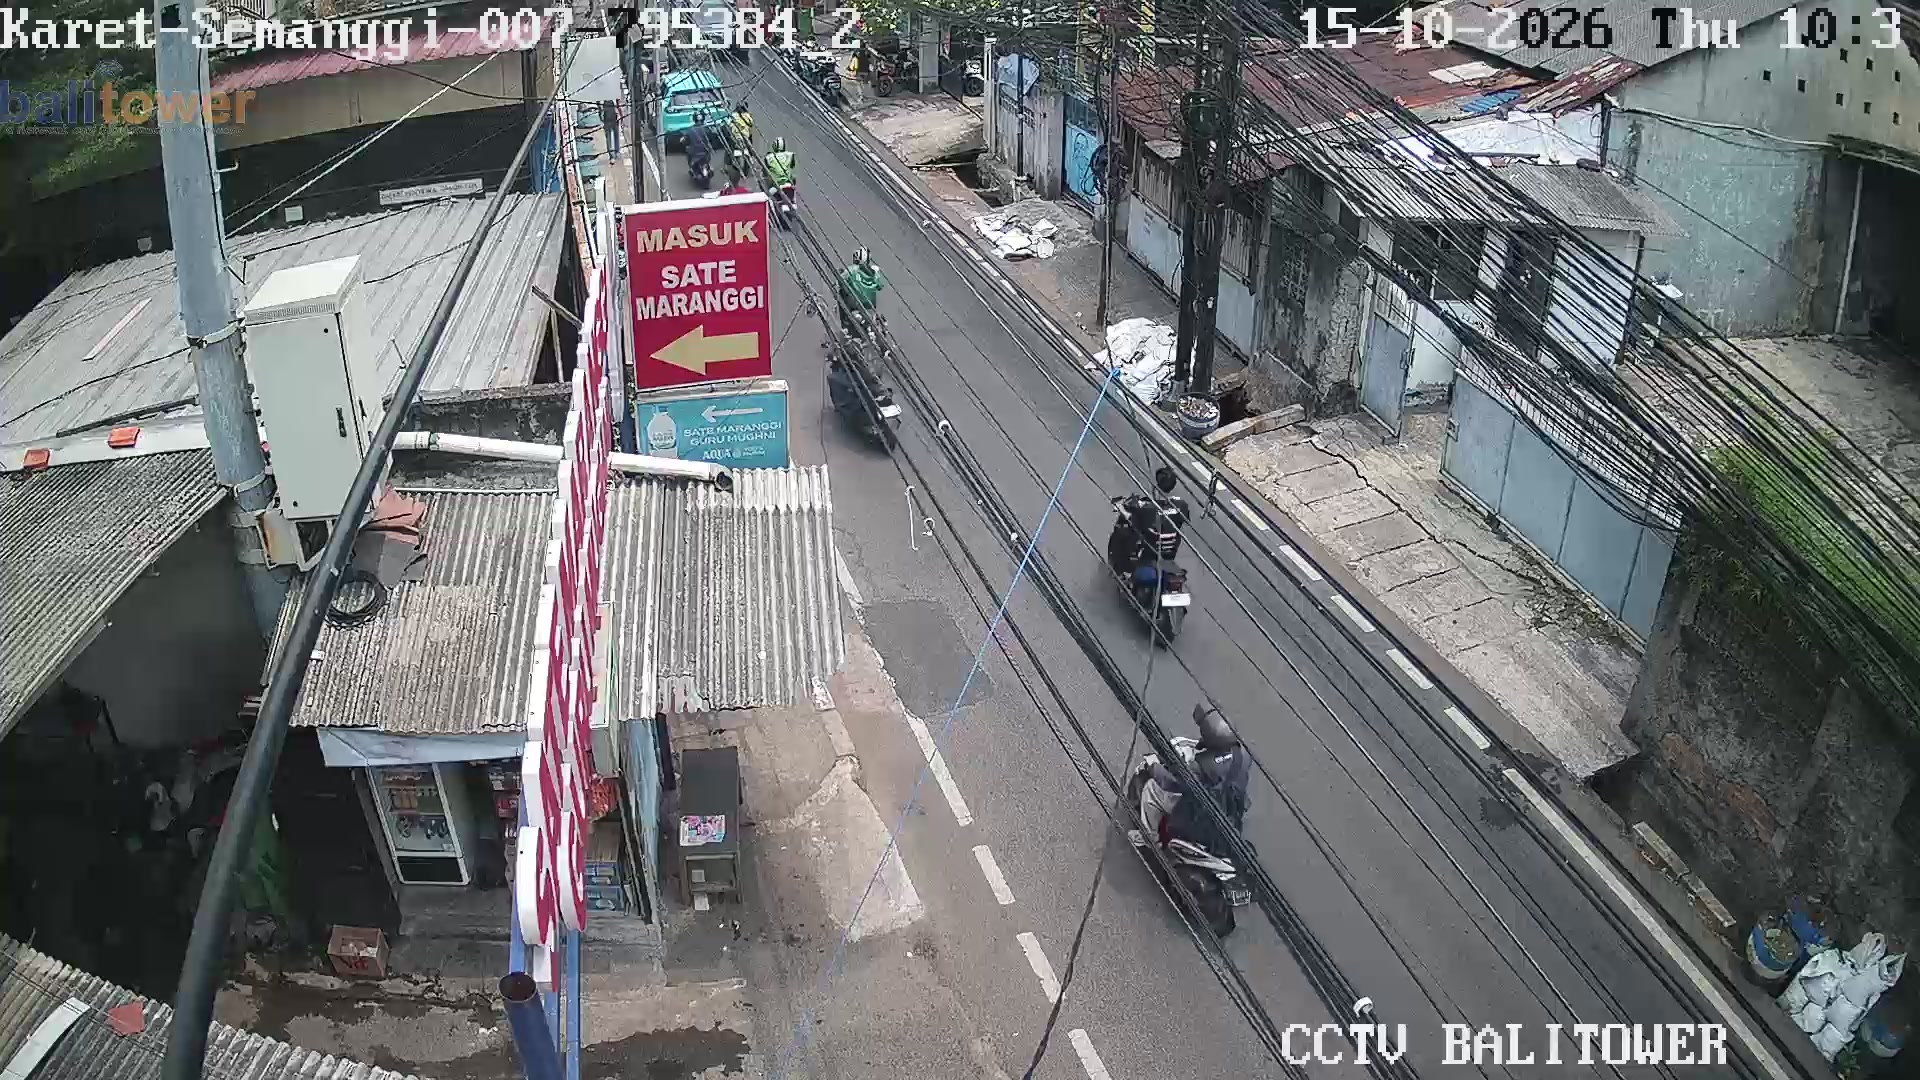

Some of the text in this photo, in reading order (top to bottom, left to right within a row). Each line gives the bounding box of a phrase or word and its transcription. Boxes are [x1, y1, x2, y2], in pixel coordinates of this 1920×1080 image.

[637, 220, 759, 253] MASUK
[661, 259, 737, 289] SATE
[636, 286, 764, 320] MARANGGI
[684, 426, 716, 437] SATE
[716, 420, 782, 433] MARANGGI
[690, 431, 776, 446] GURU MUGHNI
[702, 448, 732, 460] AQUA
